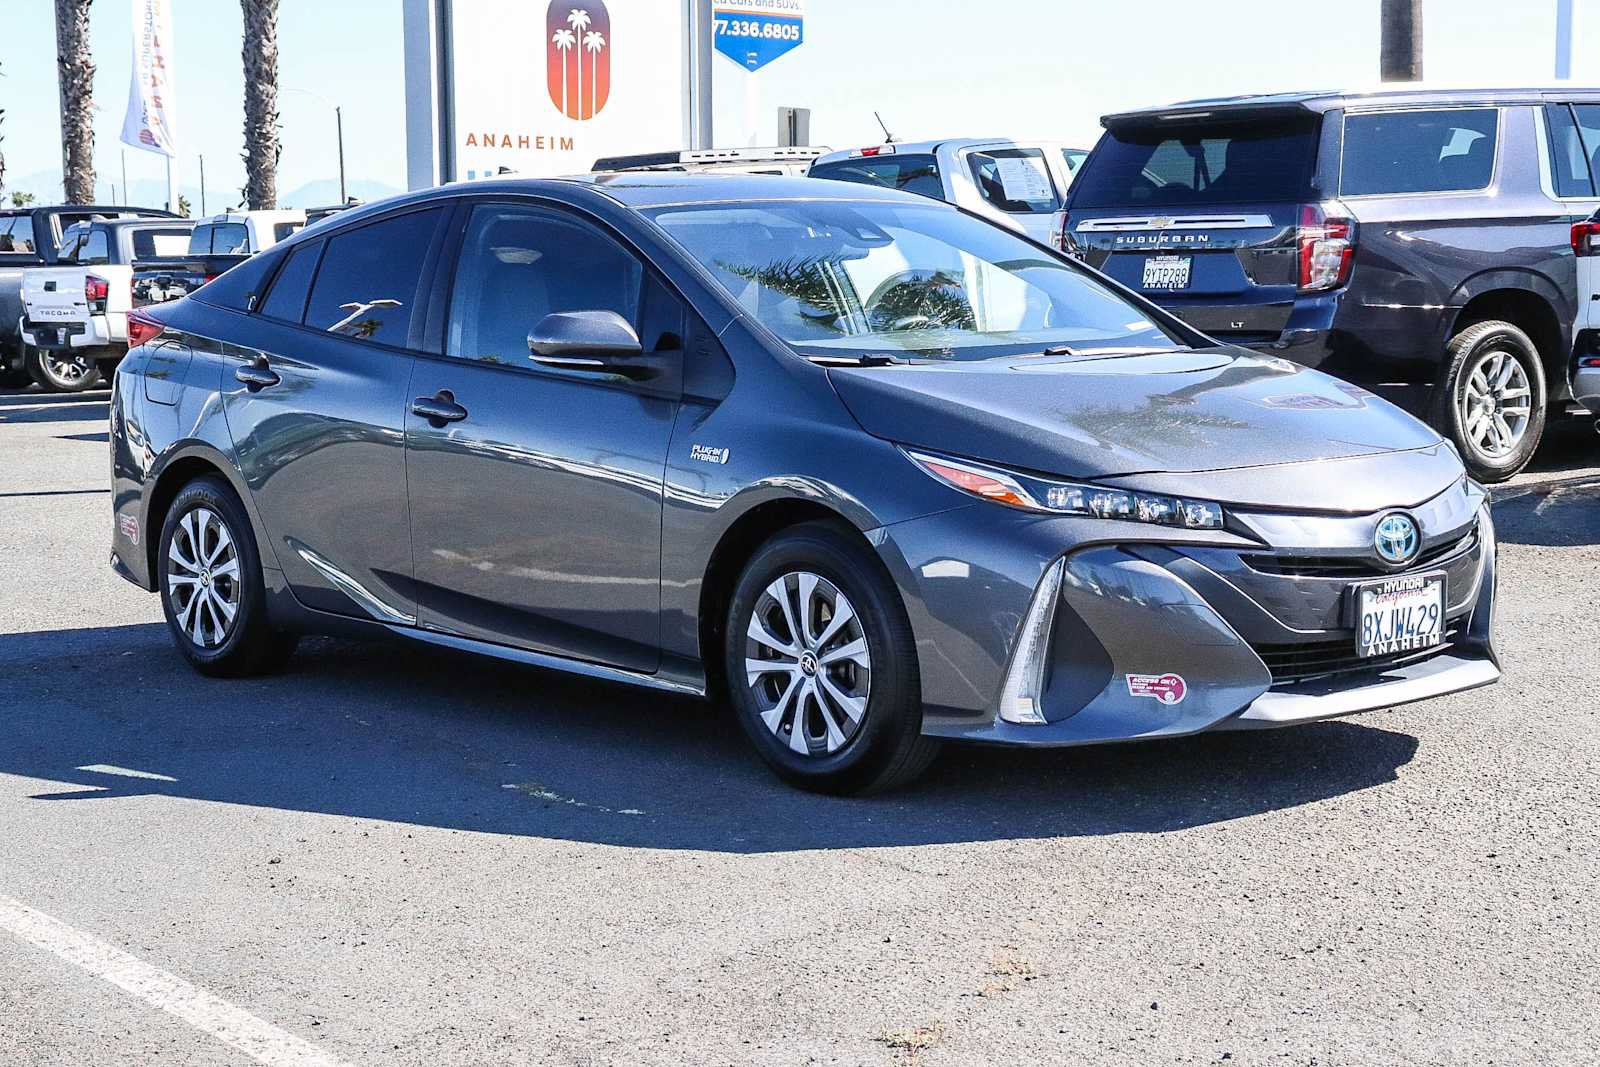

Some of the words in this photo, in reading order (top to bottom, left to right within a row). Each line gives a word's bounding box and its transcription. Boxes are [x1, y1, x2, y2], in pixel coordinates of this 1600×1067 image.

[466, 132, 574, 151] ANAHEIM
[1117, 235, 1208, 244] SUBURBAN
[1383, 577, 1425, 594] HYUNDAI
[1363, 603, 1439, 645] 8XJW429
[1366, 633, 1441, 657] ANAHEIM
